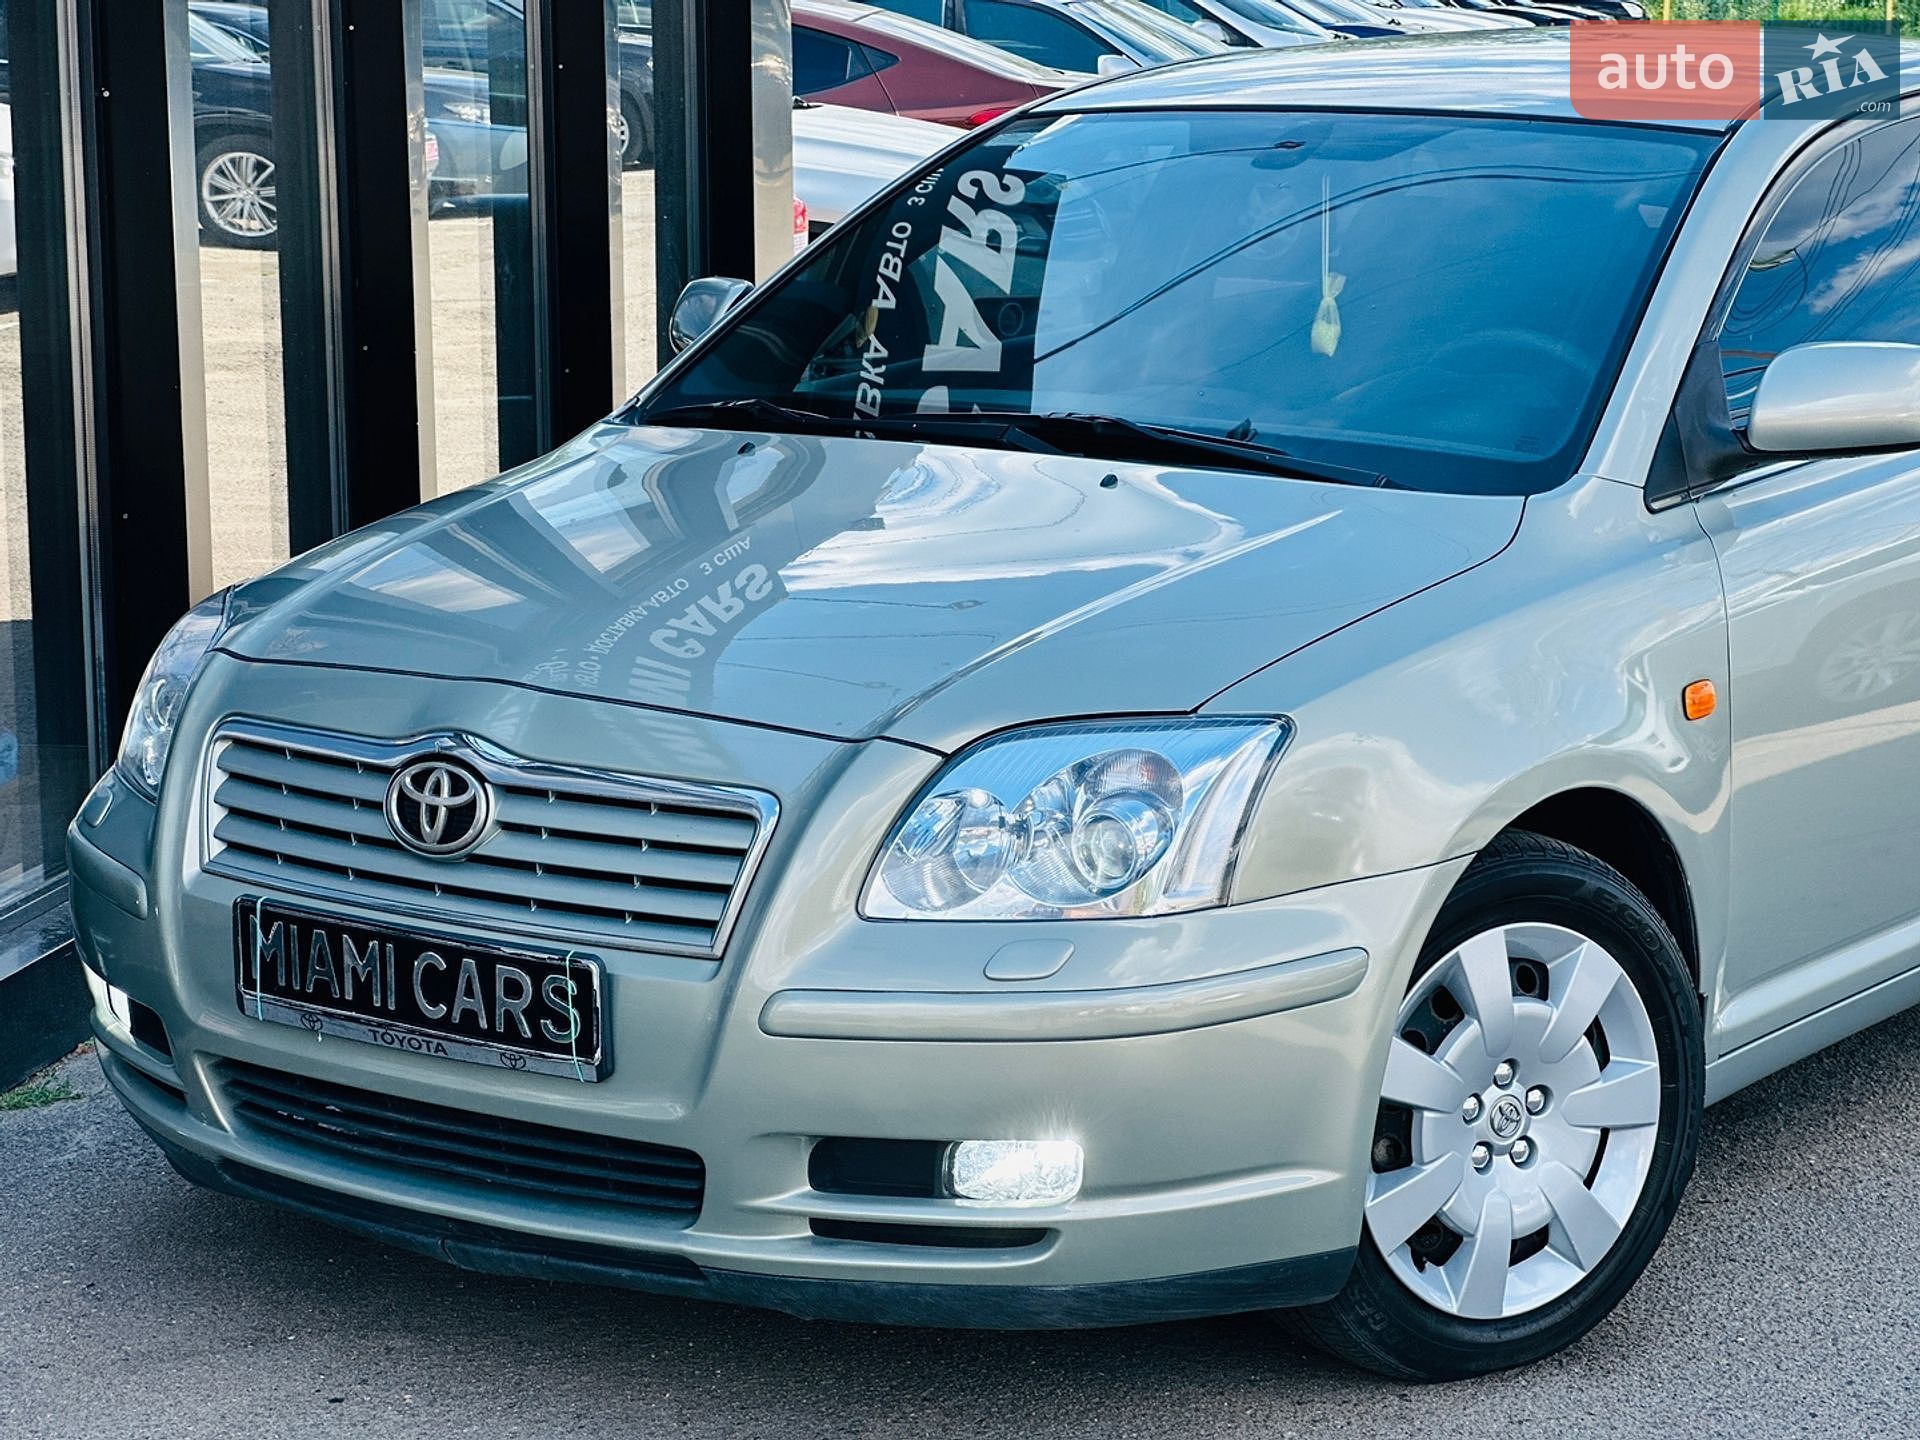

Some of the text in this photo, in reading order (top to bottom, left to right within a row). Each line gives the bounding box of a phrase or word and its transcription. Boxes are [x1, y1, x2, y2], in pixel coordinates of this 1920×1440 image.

[249, 913, 582, 1044] MIAMI CARS
[368, 1028, 449, 1056] TOYOTA
